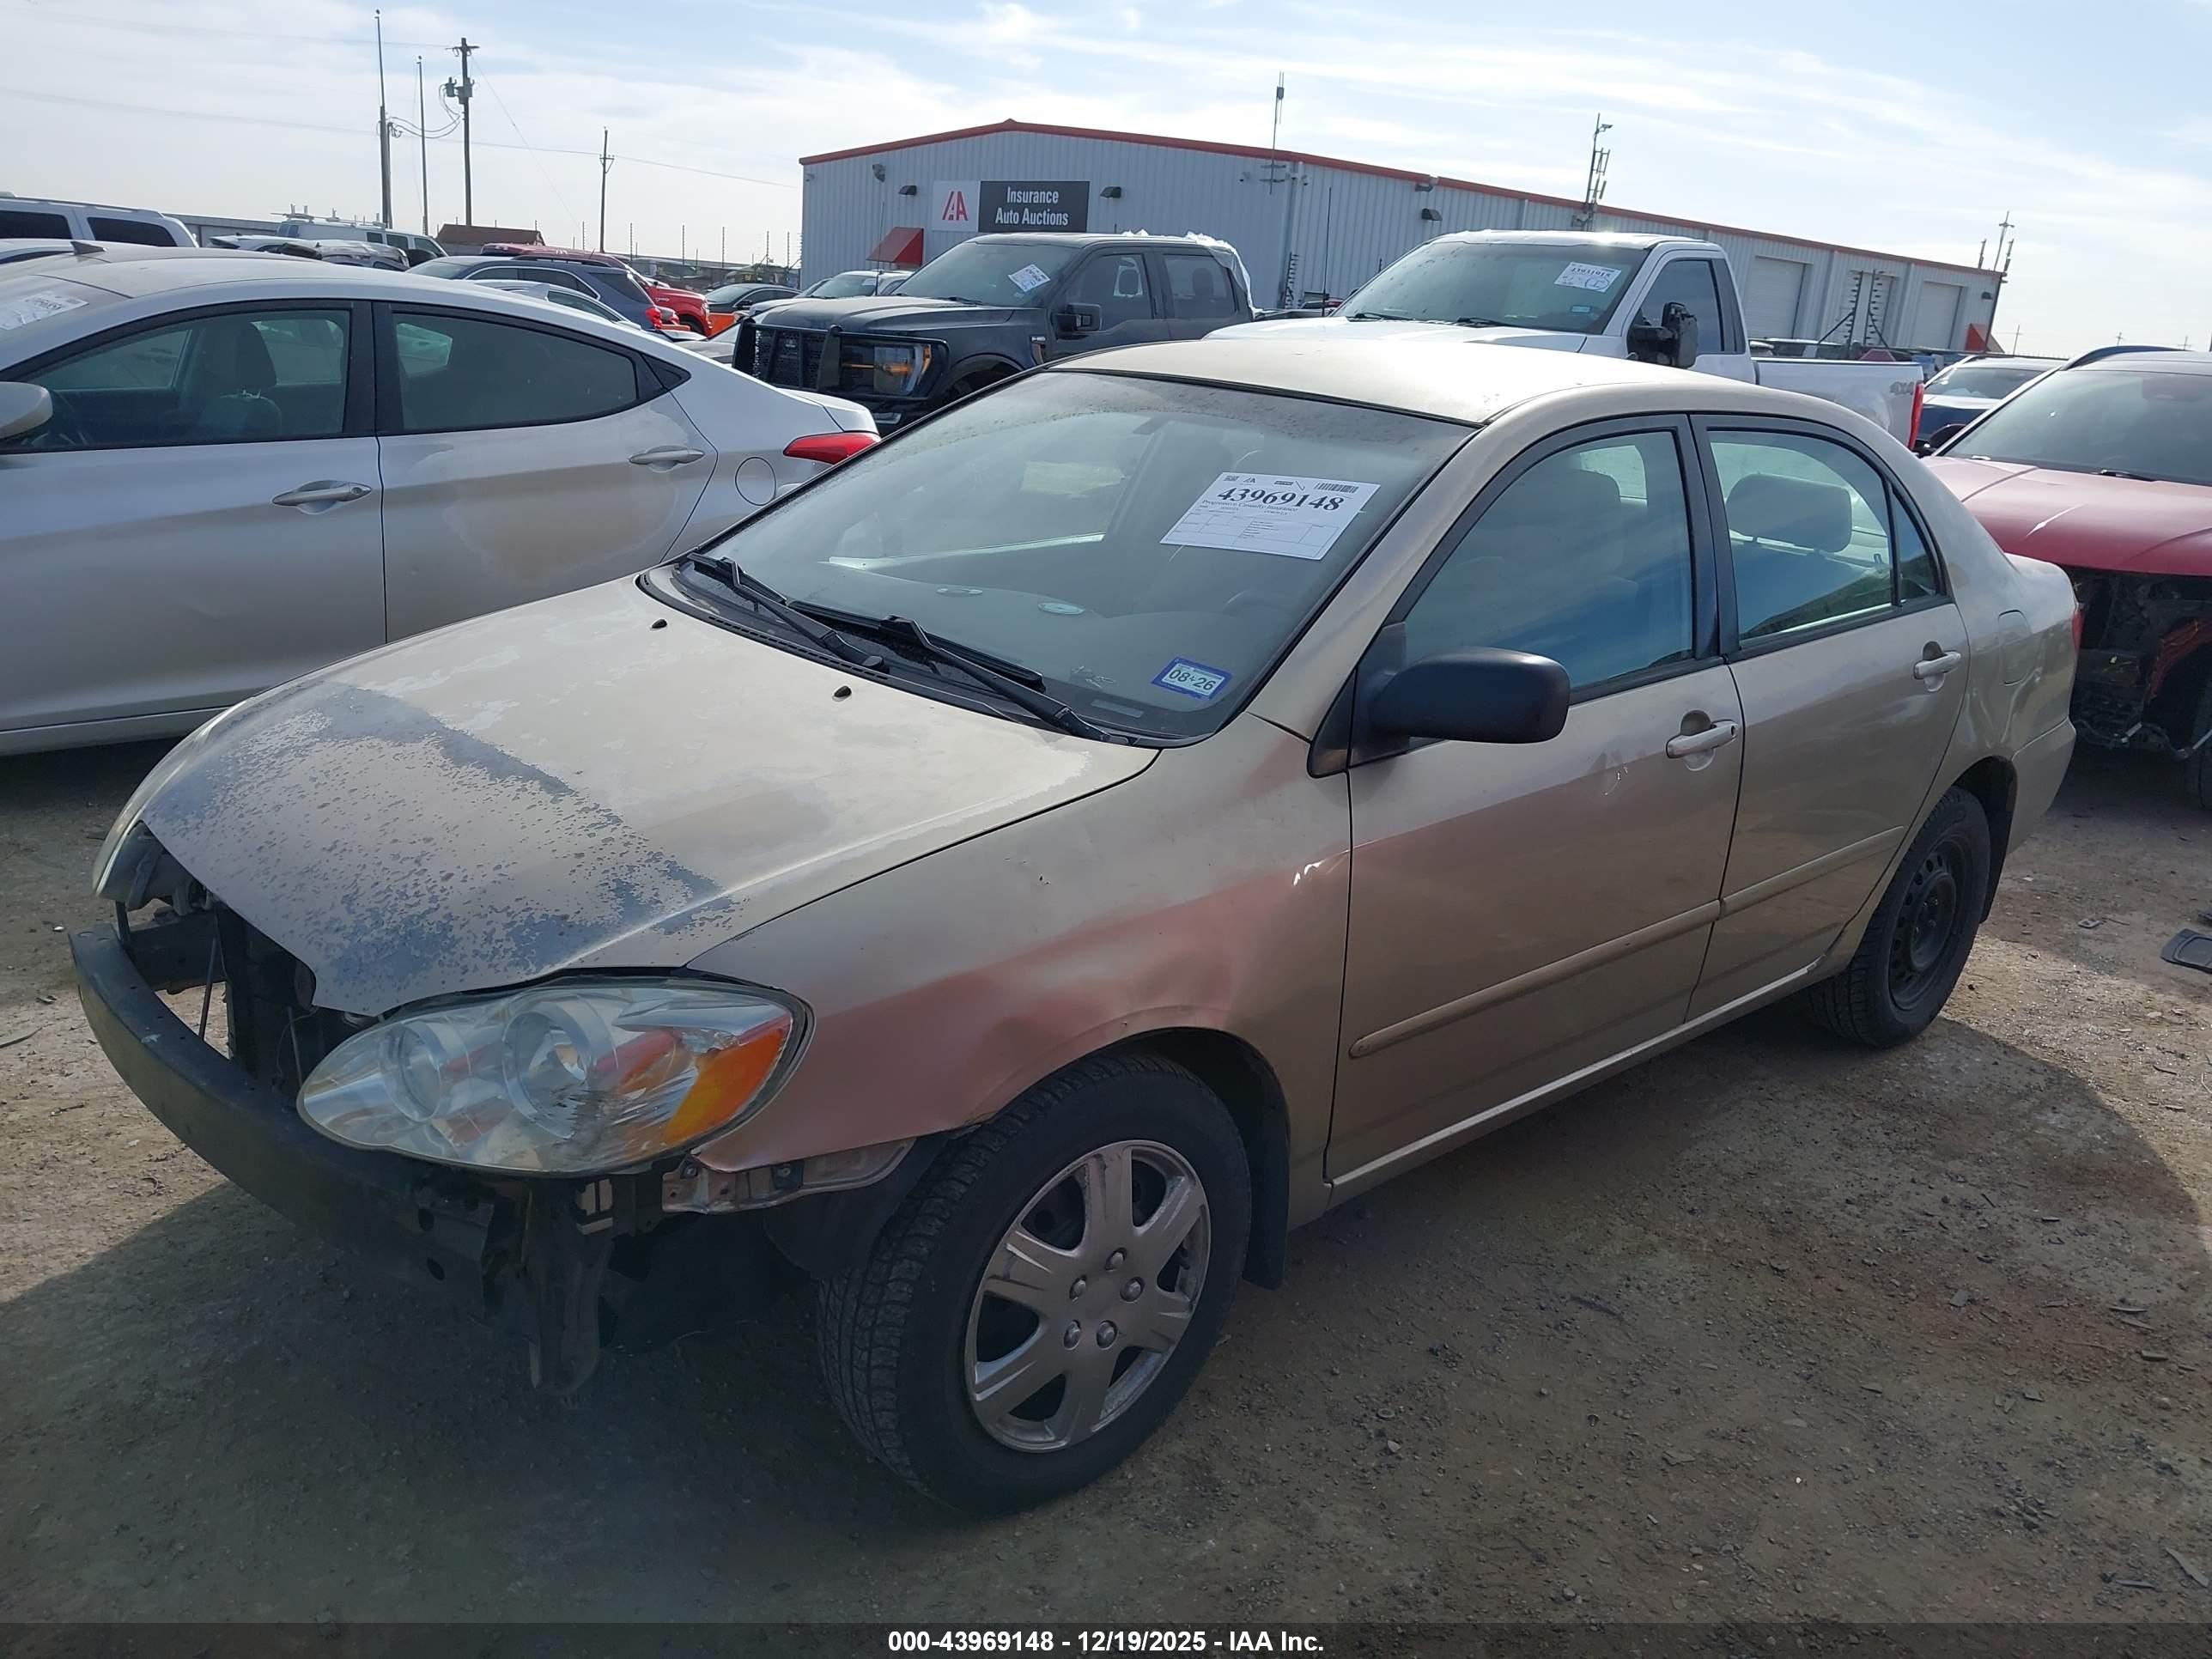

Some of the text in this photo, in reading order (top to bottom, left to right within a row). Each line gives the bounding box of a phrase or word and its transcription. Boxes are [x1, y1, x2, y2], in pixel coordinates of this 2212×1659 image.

[1006, 186, 1059, 204] Insurance
[995, 208, 1069, 226] Auto Auctions
[1217, 487, 1345, 511] 43969148
